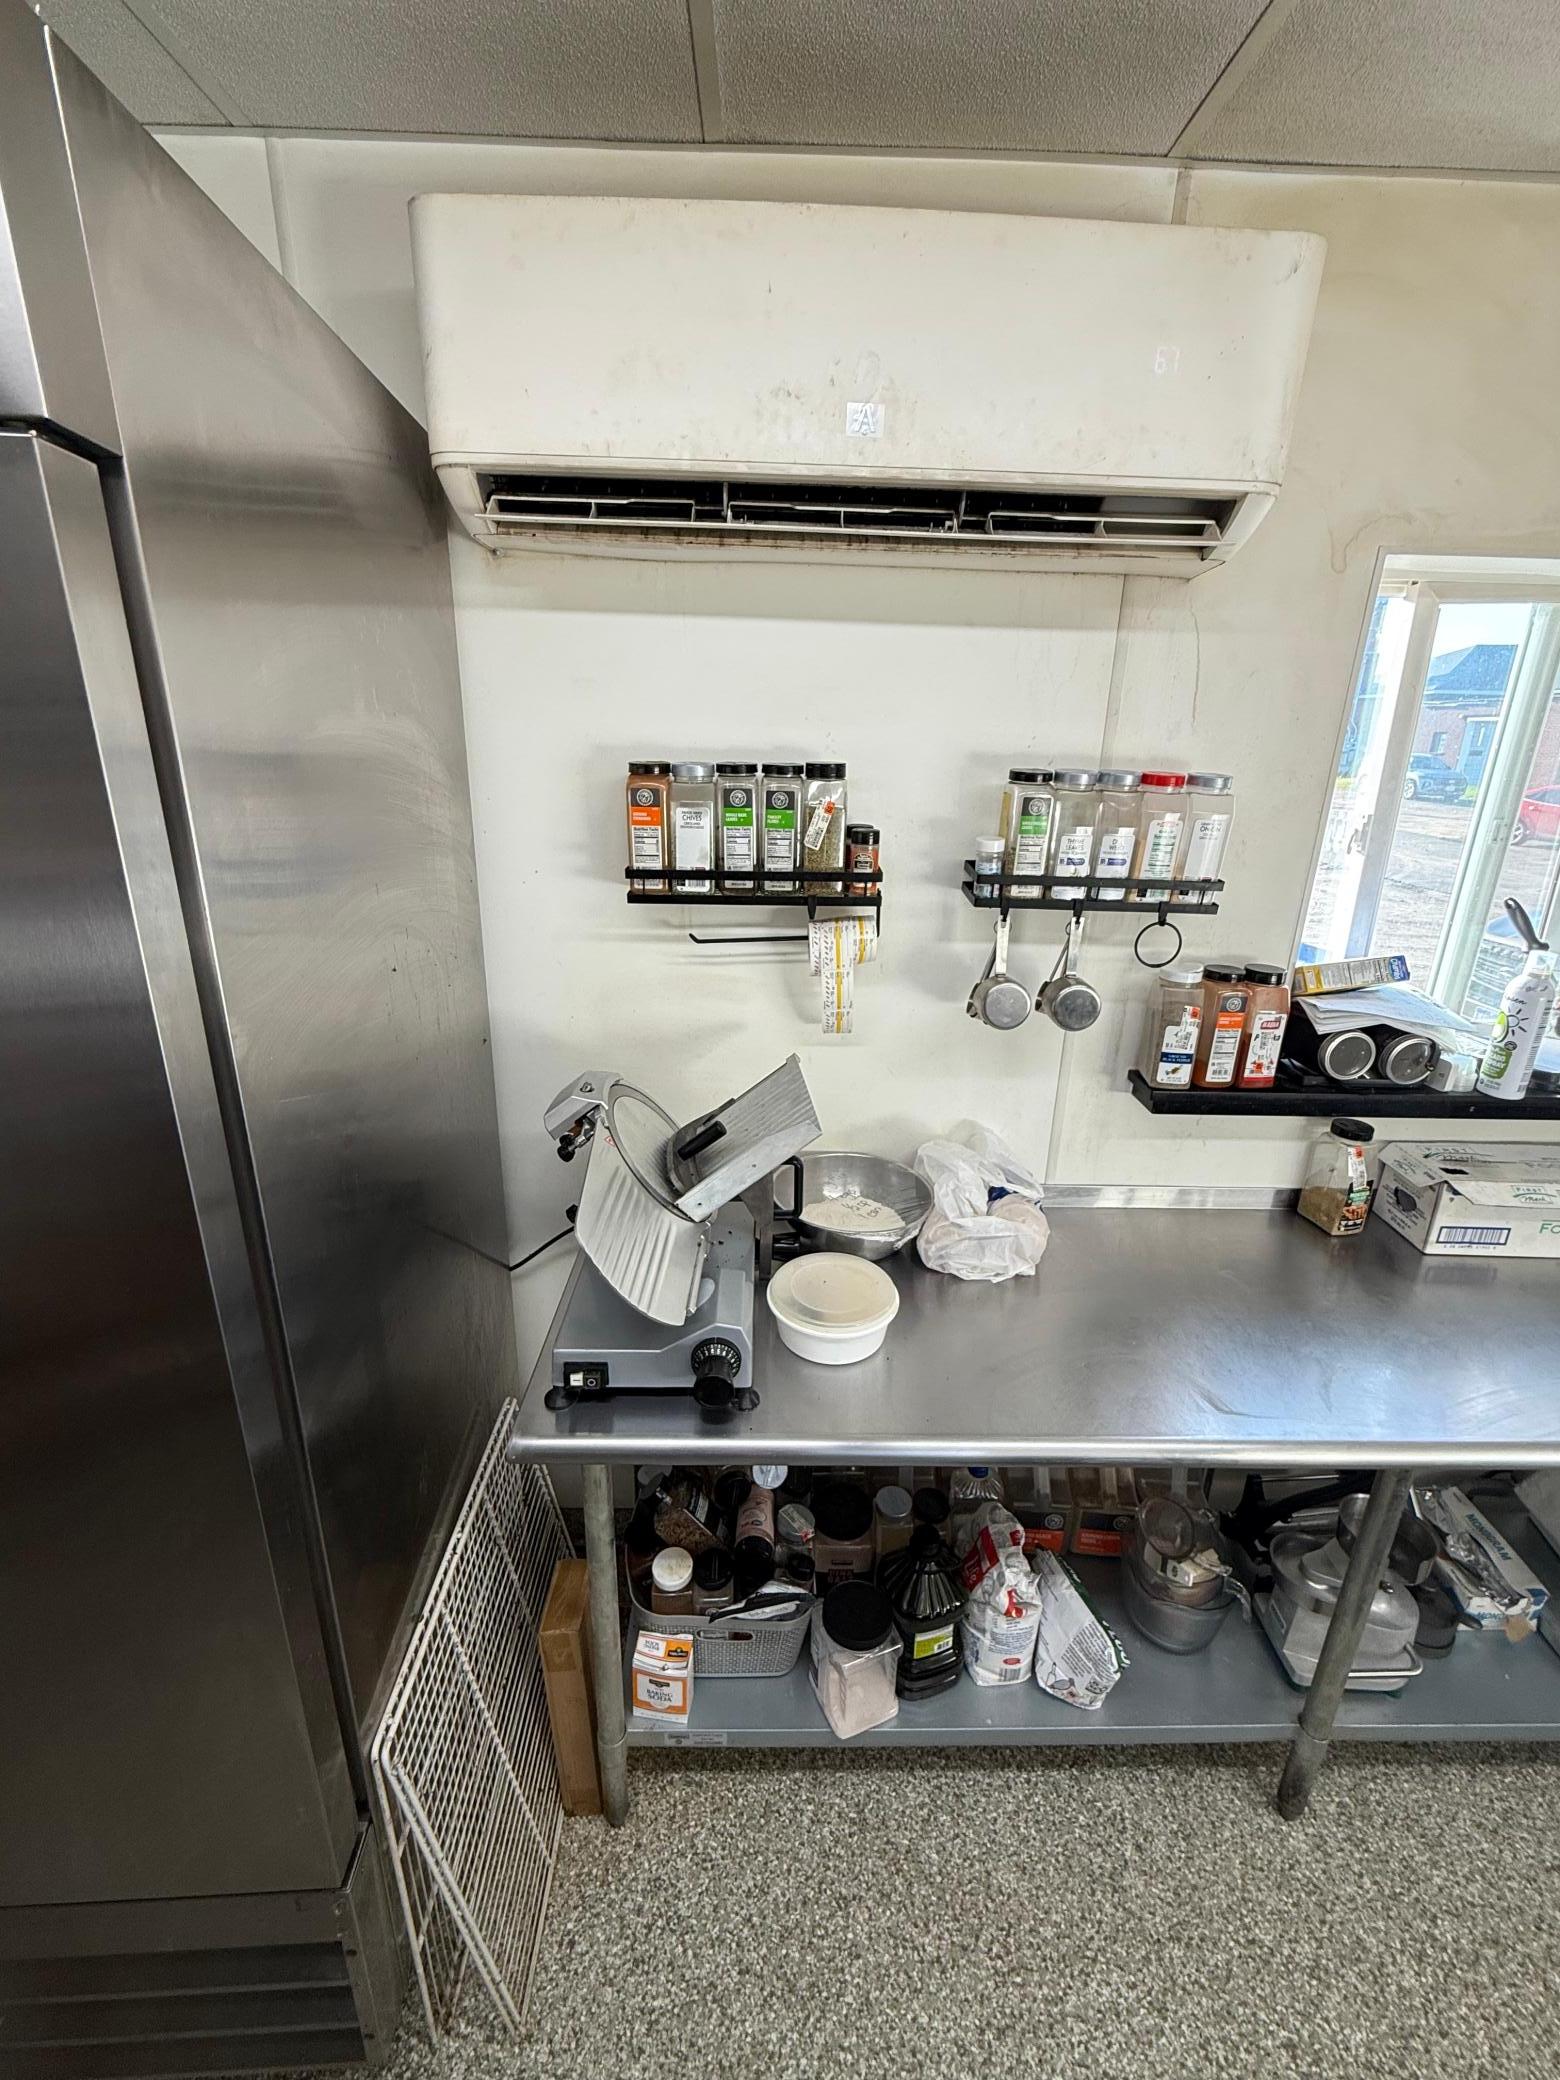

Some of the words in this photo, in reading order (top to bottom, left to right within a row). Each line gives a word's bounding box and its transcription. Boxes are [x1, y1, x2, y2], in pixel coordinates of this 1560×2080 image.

[1465, 1513, 1513, 1562] MONOGRAM
[647, 1689, 673, 1698] BAKING
[648, 1694, 672, 1702] SODA
